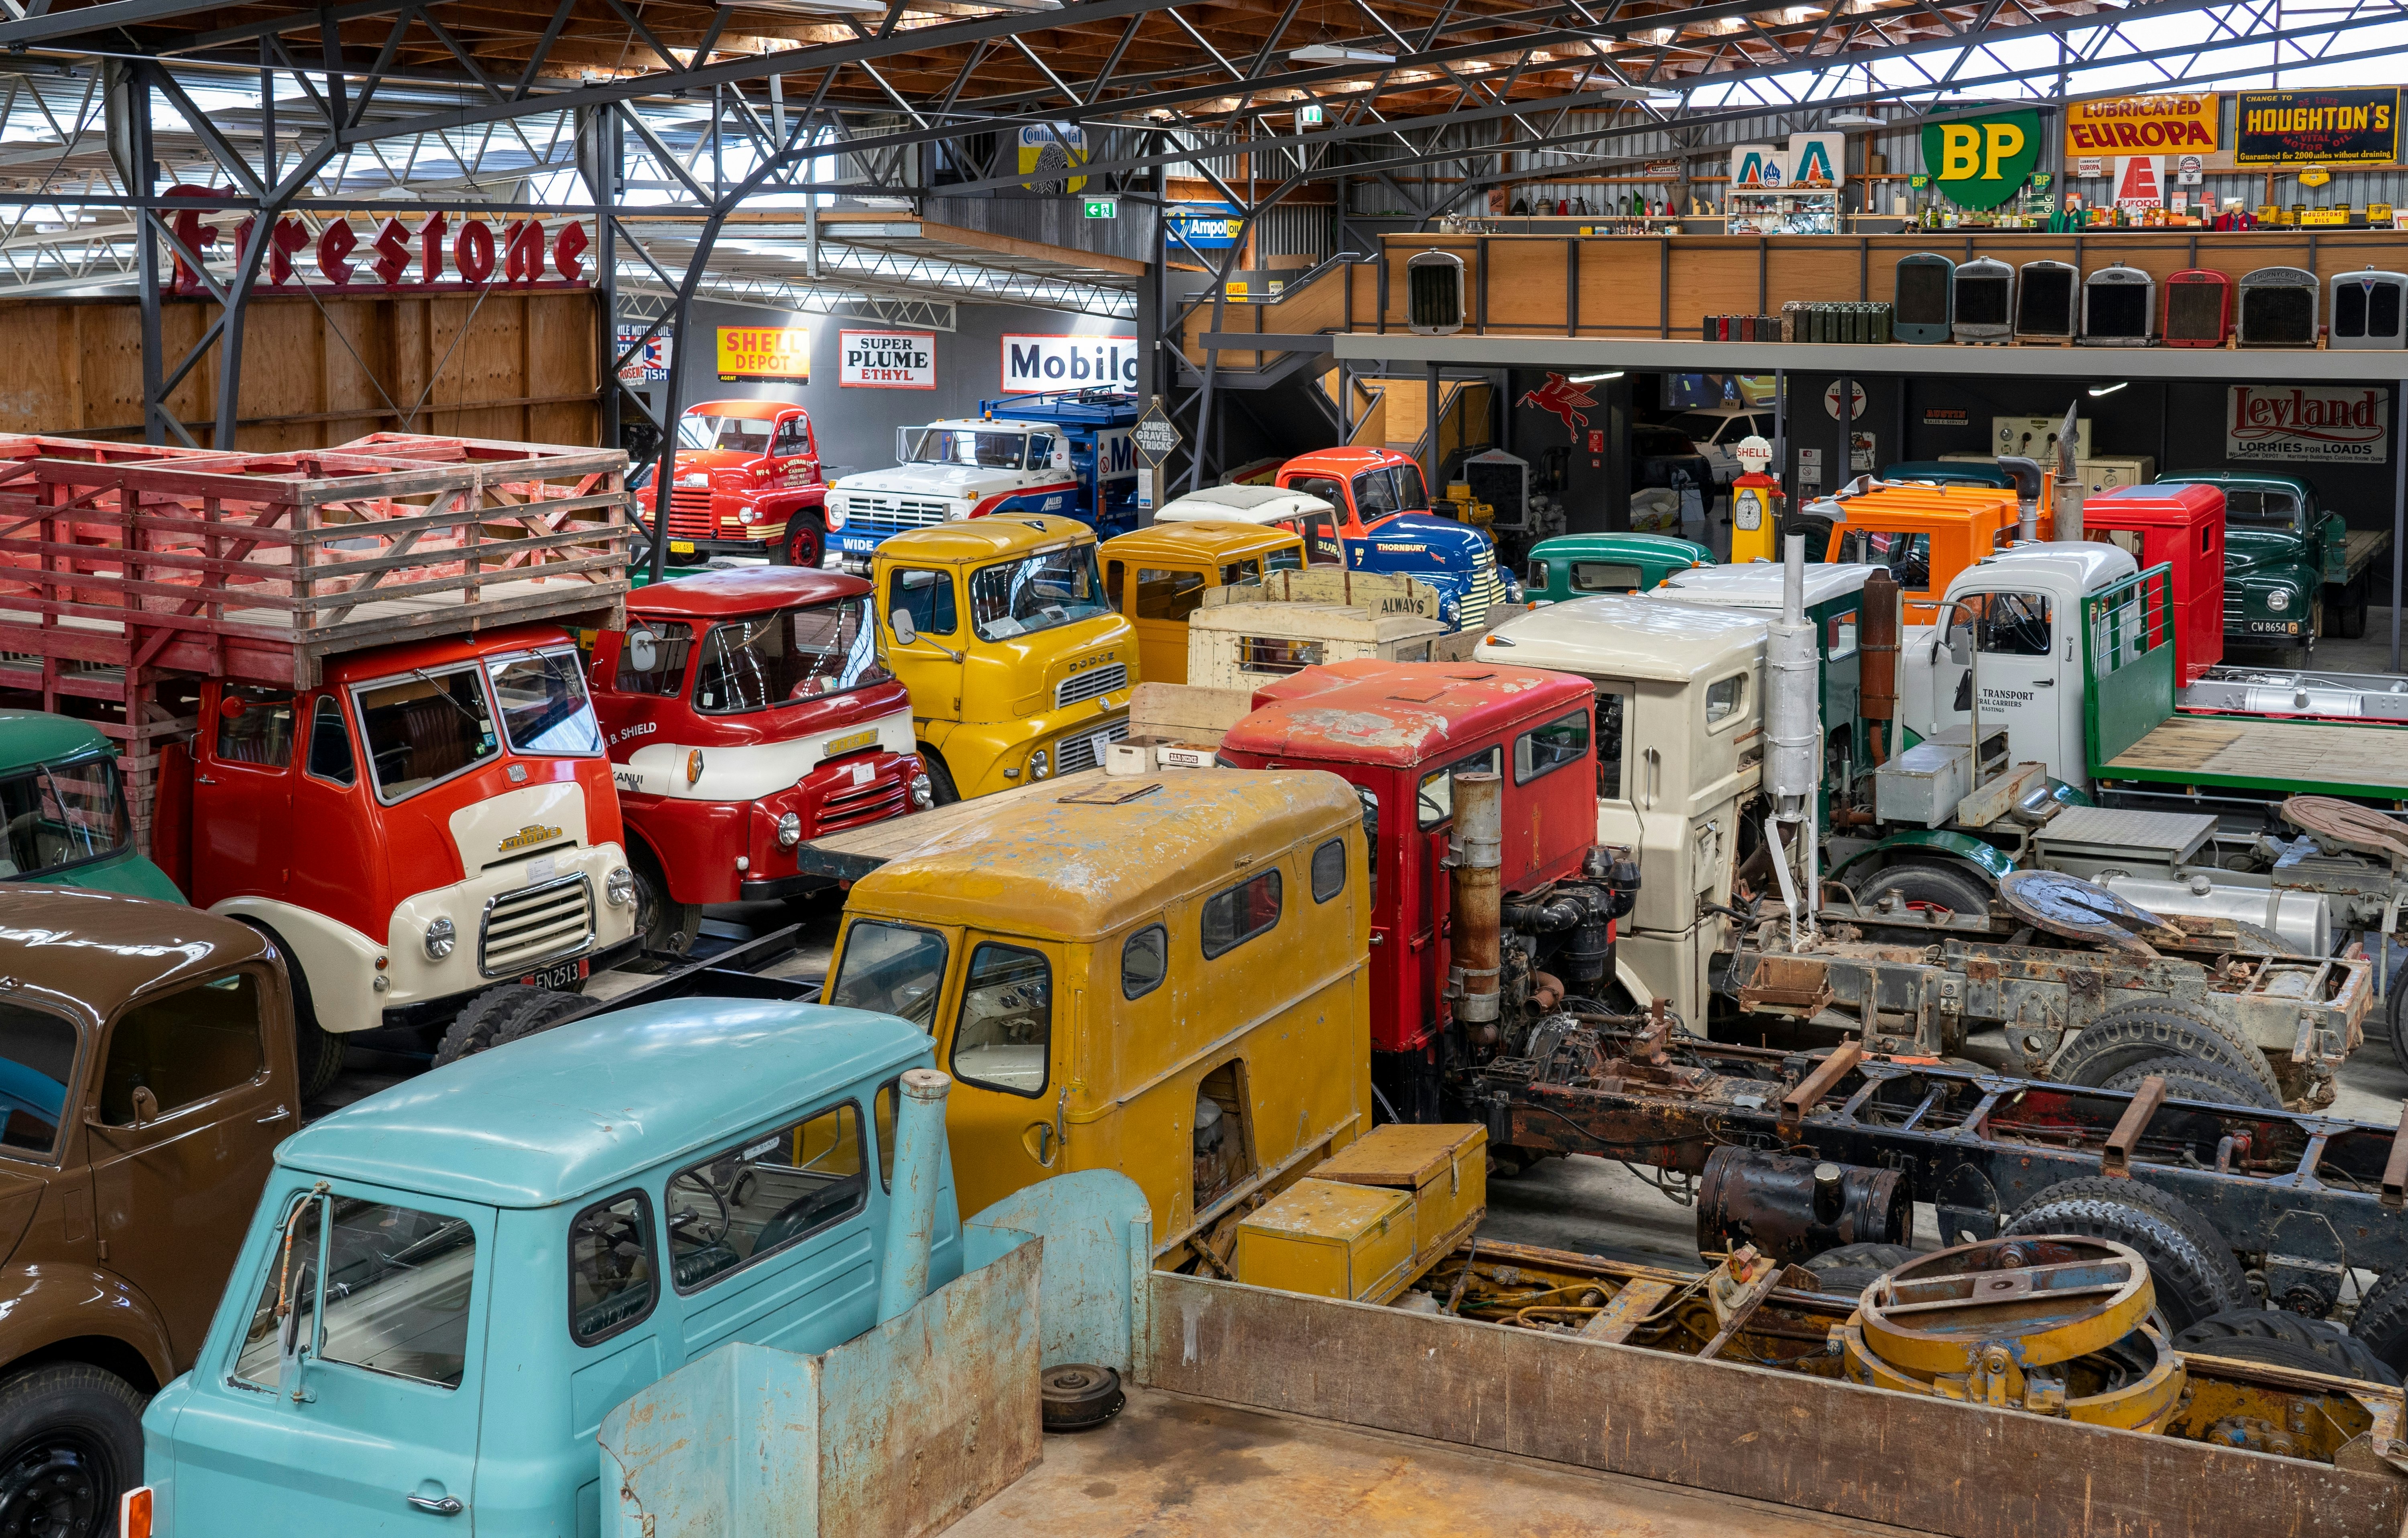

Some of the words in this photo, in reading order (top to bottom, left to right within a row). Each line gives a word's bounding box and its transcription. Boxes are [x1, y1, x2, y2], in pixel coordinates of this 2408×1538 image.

[2298, 98, 2310, 107] DE
[2315, 97, 2339, 106] LUXE
[2083, 100, 2201, 118] LUBRICATED
[2247, 102, 2390, 132] HOUGHTON'S
[1023, 127, 1081, 144] Continntal
[2069, 120, 2214, 148] EUROPA
[2300, 134, 2330, 142] VITAL
[2282, 136, 2323, 151] MOTOR
[2332, 134, 2353, 147] OIL
[1937, 124, 2025, 181] BP
[2334, 151, 2359, 159] without
[2361, 150, 2391, 159] draining
[2181, 156, 2200, 166] LUBRICATED
[1763, 158, 1781, 181] BLUE
[1912, 177, 1927, 187] BP
[2034, 175, 2050, 186] BP
[1191, 219, 1227, 238] Ampol
[156, 183, 589, 295] Firestone
[2253, 272, 2304, 281] THORNYCROFT
[1228, 284, 1247, 294] SHELL
[726, 332, 800, 353] SHELL
[861, 338, 913, 350] SUPER
[736, 354, 790, 370] DEPOT
[847, 351, 928, 368] PLUME
[861, 368, 914, 381] ETHYL
[1926, 409, 1966, 418] AUSTIN
[2232, 387, 2382, 435] Leyland
[1142, 421, 1170, 432] DANGER
[1136, 430, 1174, 442] GRAVEL
[1140, 440, 1172, 451] TRUCKS
[2239, 441, 2302, 452] LORRIES
[2323, 444, 2373, 454] LOADS
[1737, 447, 1769, 457] SHELL
[787, 459, 806, 467] HEENAN
[783, 479, 811, 487] WOODLANDS
[843, 538, 874, 551] WIDE
[1377, 543, 1427, 552] THORNBURY
[1356, 557, 1363, 566] 7
[1381, 598, 1424, 614] ALWAYS
[2251, 622, 2264, 632] CW
[2266, 622, 2286, 632] 8654
[2290, 624, 2296, 633] G
[1069, 651, 1115, 672] DODGE
[1983, 688, 2034, 700] TRANSPORT
[1992, 699, 2022, 707] CARRIERS
[610, 734, 620, 745] B.
[620, 722, 657, 740] SHIELD
[505, 828, 558, 848] MORRIS
[759, 1139, 778, 1150] BLAIR
